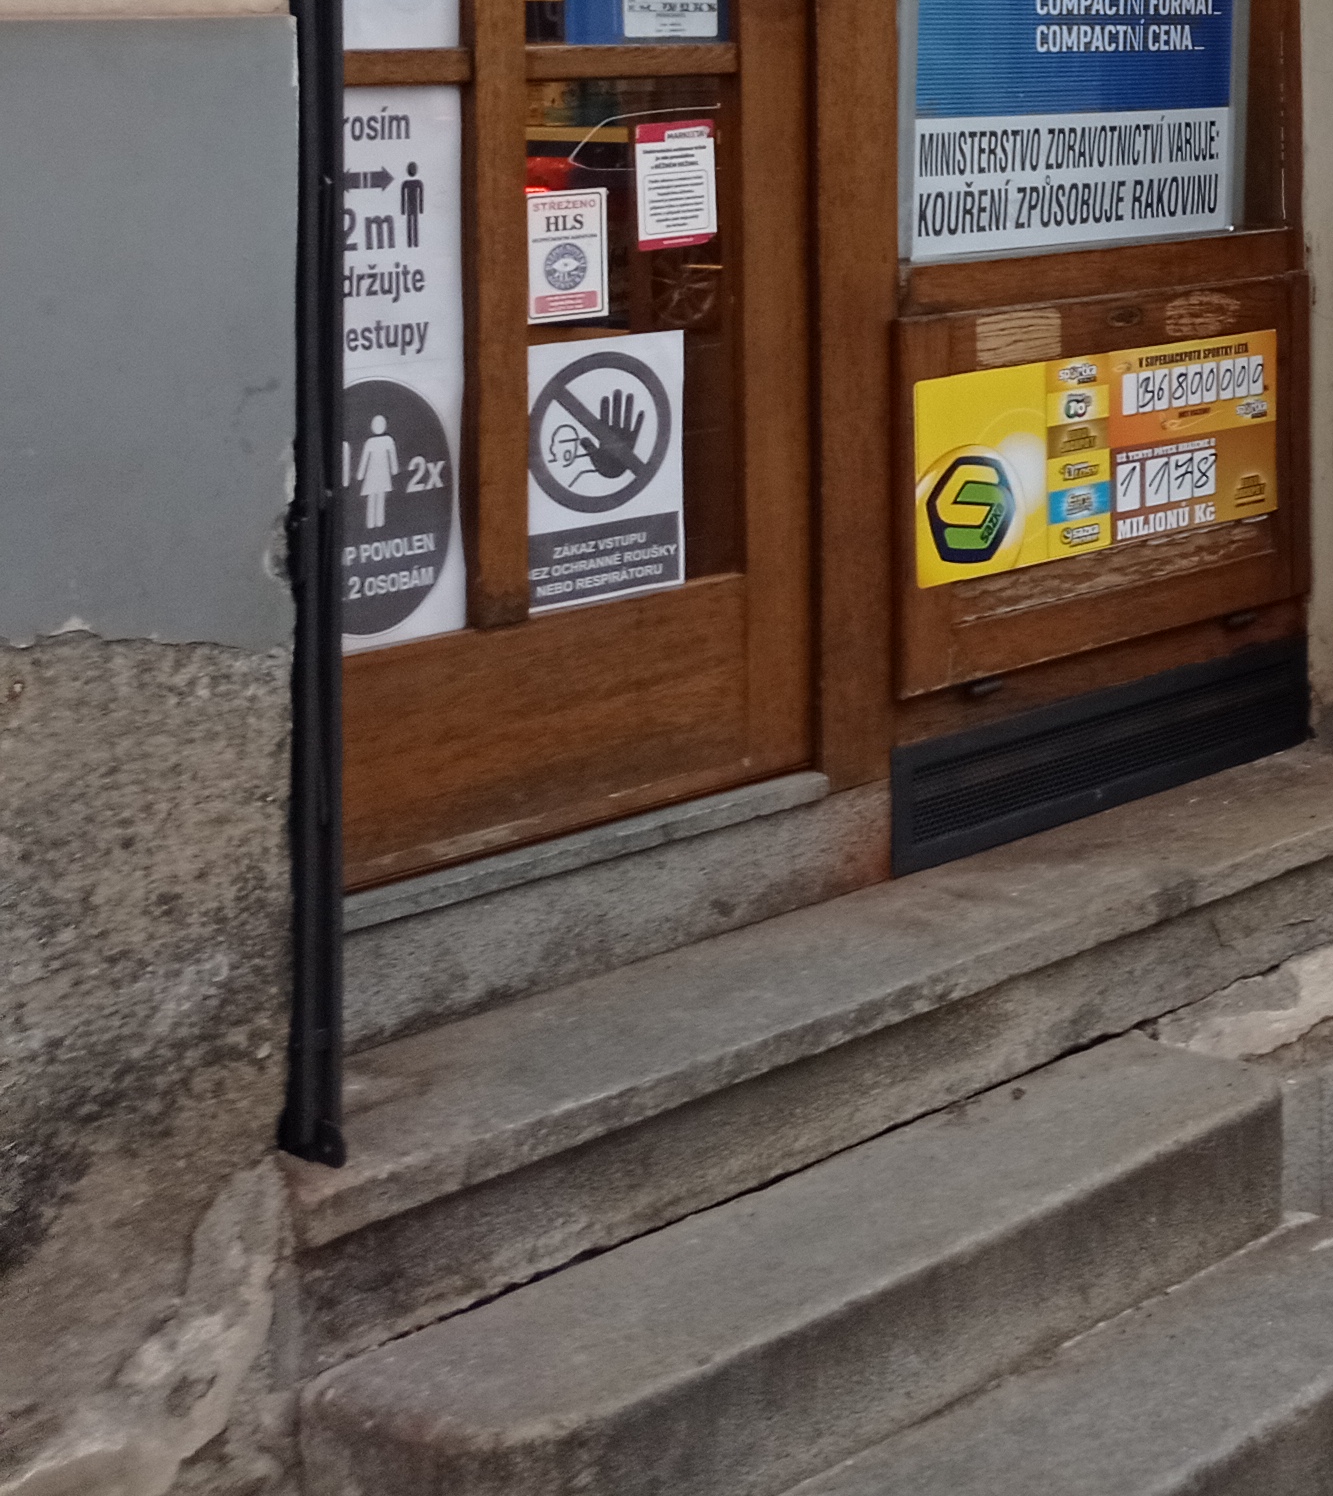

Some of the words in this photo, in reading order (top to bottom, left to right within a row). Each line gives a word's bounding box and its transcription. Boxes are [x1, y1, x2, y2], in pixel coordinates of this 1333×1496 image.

[1035, 19, 1145, 53] COMPACTNÍ
[919, 129, 1041, 178] MINISTERSTVO
[1045, 116, 1165, 170] ZDRAVOTNICTVÍ
[1167, 120, 1219, 164] VARUJE:
[532, 199, 596, 212] STŘEŽENO
[545, 213, 584, 232] HLS
[917, 180, 1010, 237] KOUŘENÍ
[1015, 175, 1125, 229] ZPŮSOBUJE
[1131, 174, 1219, 221] RAKOVINU
[406, 456, 445, 493] 2x
[1117, 502, 1189, 540] MILIONŮ
[1194, 502, 1216, 524] Kč
[360, 533, 435, 563] POVOLEN
[551, 552, 622, 577] OCHRANNÉ
[623, 543, 677, 563] ROUŠKY
[553, 541, 596, 559] ZÁKAZ
[597, 532, 647, 551] VSTUPU
[364, 565, 434, 596] OSOBÁM
[536, 580, 574, 598] NEBO
[575, 563, 663, 590] RESPIRÁTORU
